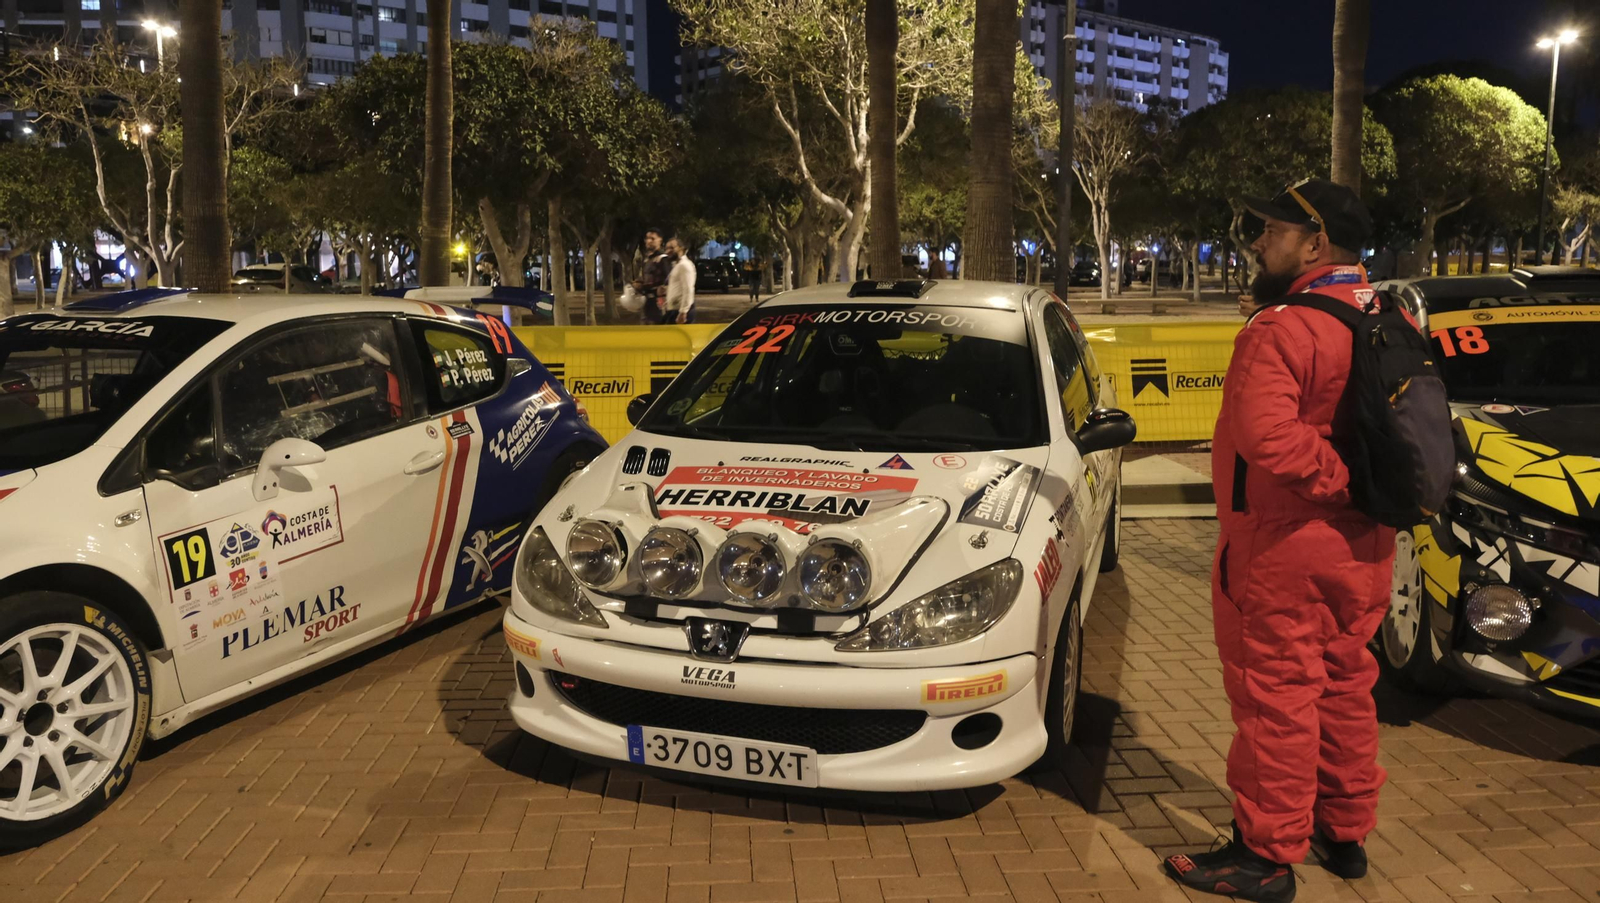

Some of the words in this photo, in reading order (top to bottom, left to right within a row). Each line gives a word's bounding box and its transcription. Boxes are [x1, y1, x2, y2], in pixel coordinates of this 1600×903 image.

[1507, 310, 1587, 318] AUTOMÓVIL
[30, 320, 154, 337] GARCÍA
[475, 314, 513, 354] 19
[728, 324, 795, 355] 22
[1430, 325, 1490, 357] 18
[444, 350, 457, 367] J.
[455, 347, 487, 365] Pérez
[450, 369, 464, 386] P.
[463, 365, 495, 384] Pérez
[1176, 374, 1225, 389] Recalv
[572, 380, 630, 395] Recalvi
[506, 397, 544, 448] AGRICOLAS
[508, 415, 546, 464] PEREZ
[740, 456, 850, 467] REALGRAPHIC
[696, 467, 788, 477] BLANQUEO
[808, 471, 878, 483] LAVADO
[726, 475, 862, 490] INVERNADEROS
[655, 489, 872, 517] HERRIBLAN
[289, 511, 318, 527] COSTA
[318, 505, 330, 517] DE
[283, 517, 333, 547] ALMERÍA
[172, 534, 207, 584] 19
[230, 556, 241, 569] 30
[221, 585, 347, 660] PLEMAR
[303, 602, 362, 643] SPORT
[107, 622, 148, 689] MICHELIN
[681, 677, 737, 689] MOTORSPORT
[682, 665, 736, 683] VEGA
[926, 674, 1003, 702] PIRELLI
[652, 734, 733, 772] 3709
[745, 747, 809, 782] BXT
[1171, 854, 1193, 872] OMP
